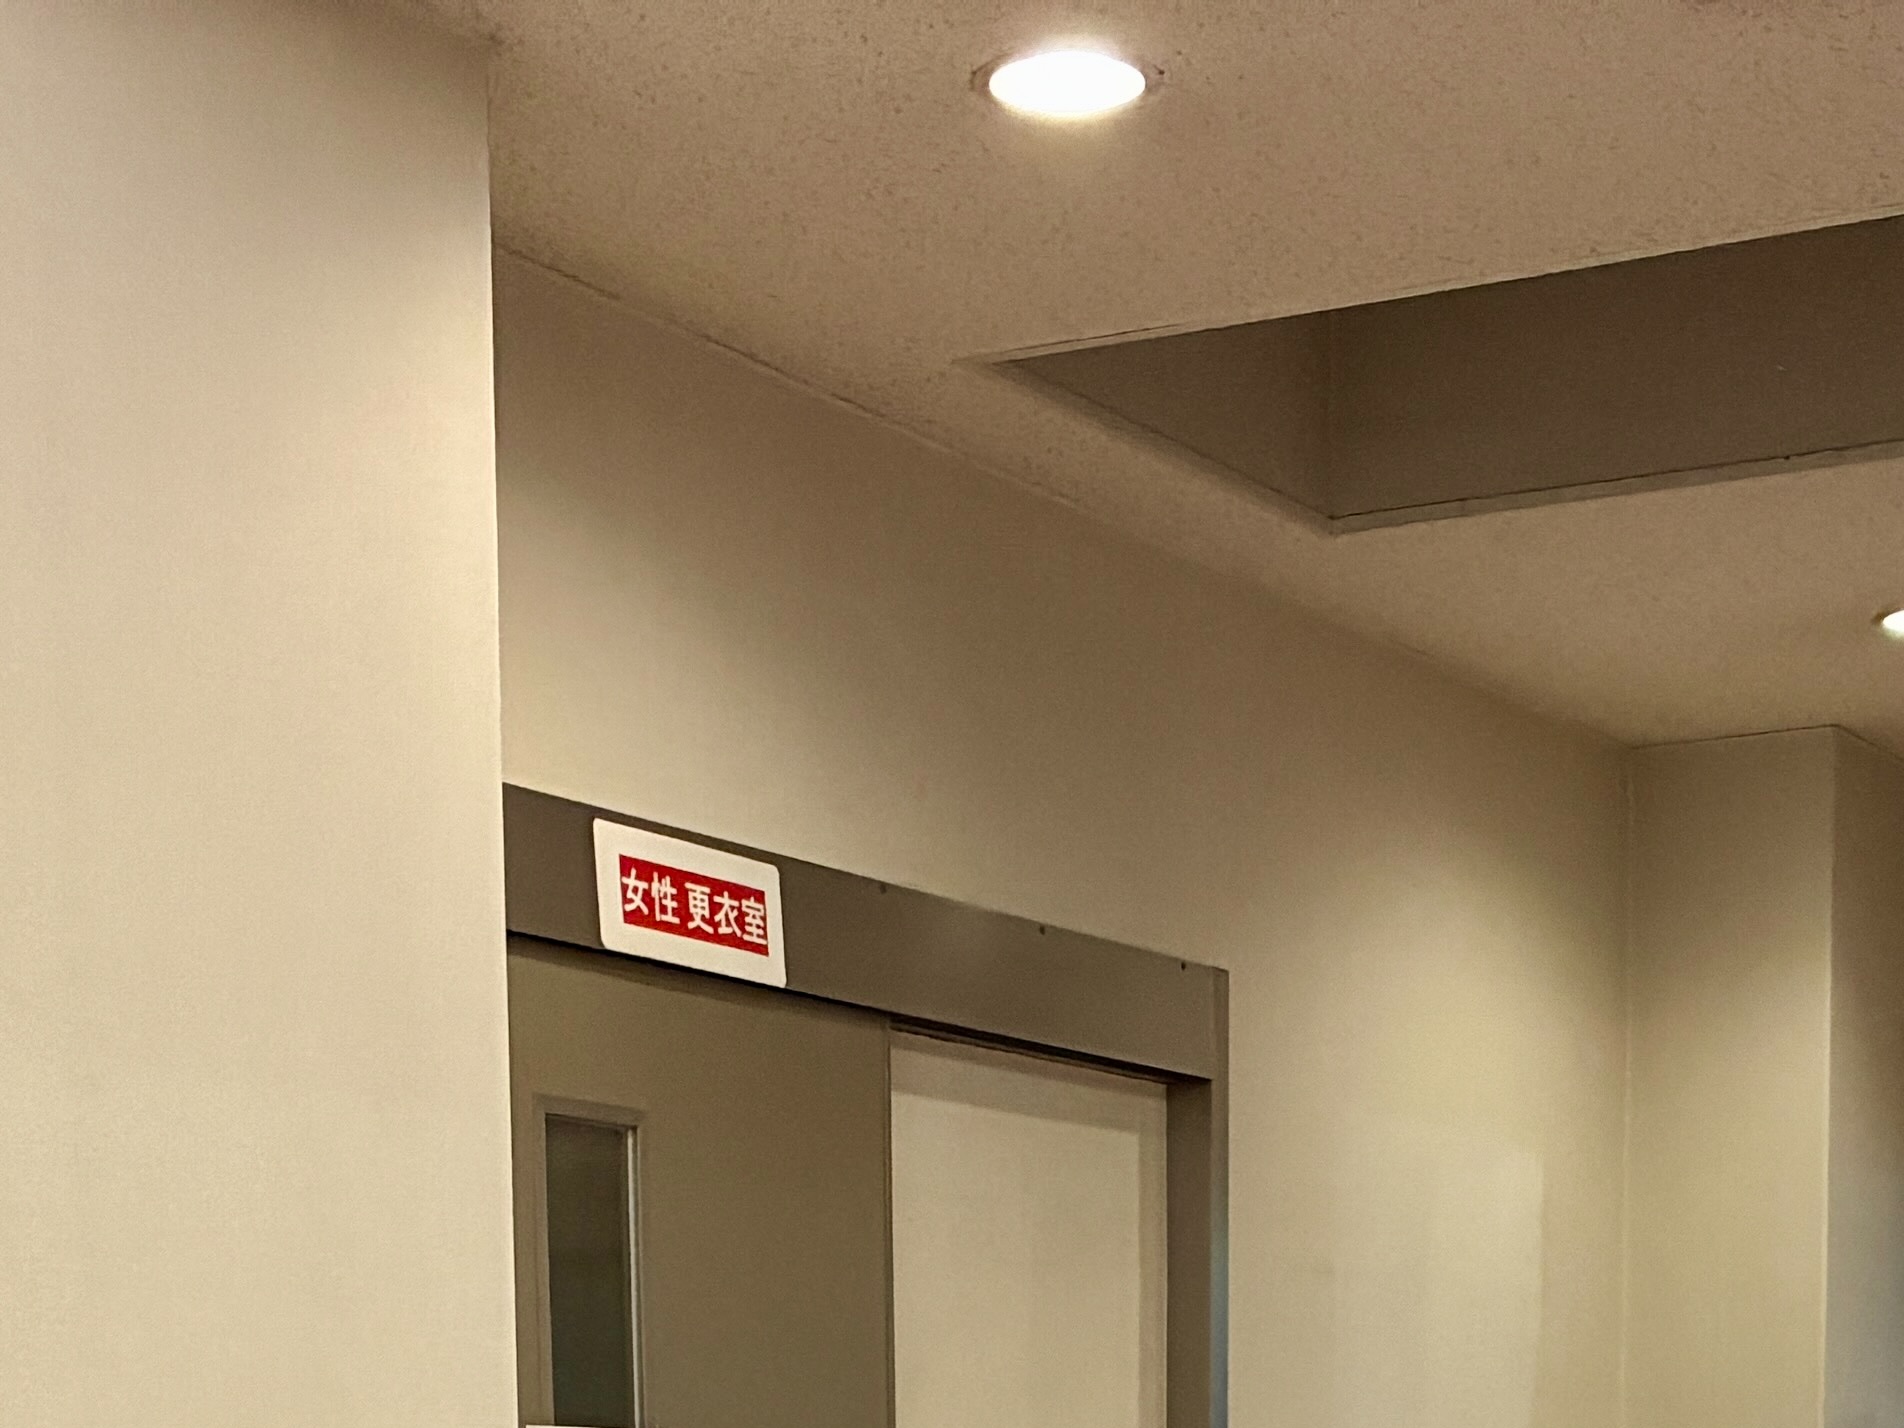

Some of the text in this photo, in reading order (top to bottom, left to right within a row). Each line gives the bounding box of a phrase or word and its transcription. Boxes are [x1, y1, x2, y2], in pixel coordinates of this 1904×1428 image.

[621, 867, 768, 945] 女性 更衣室
